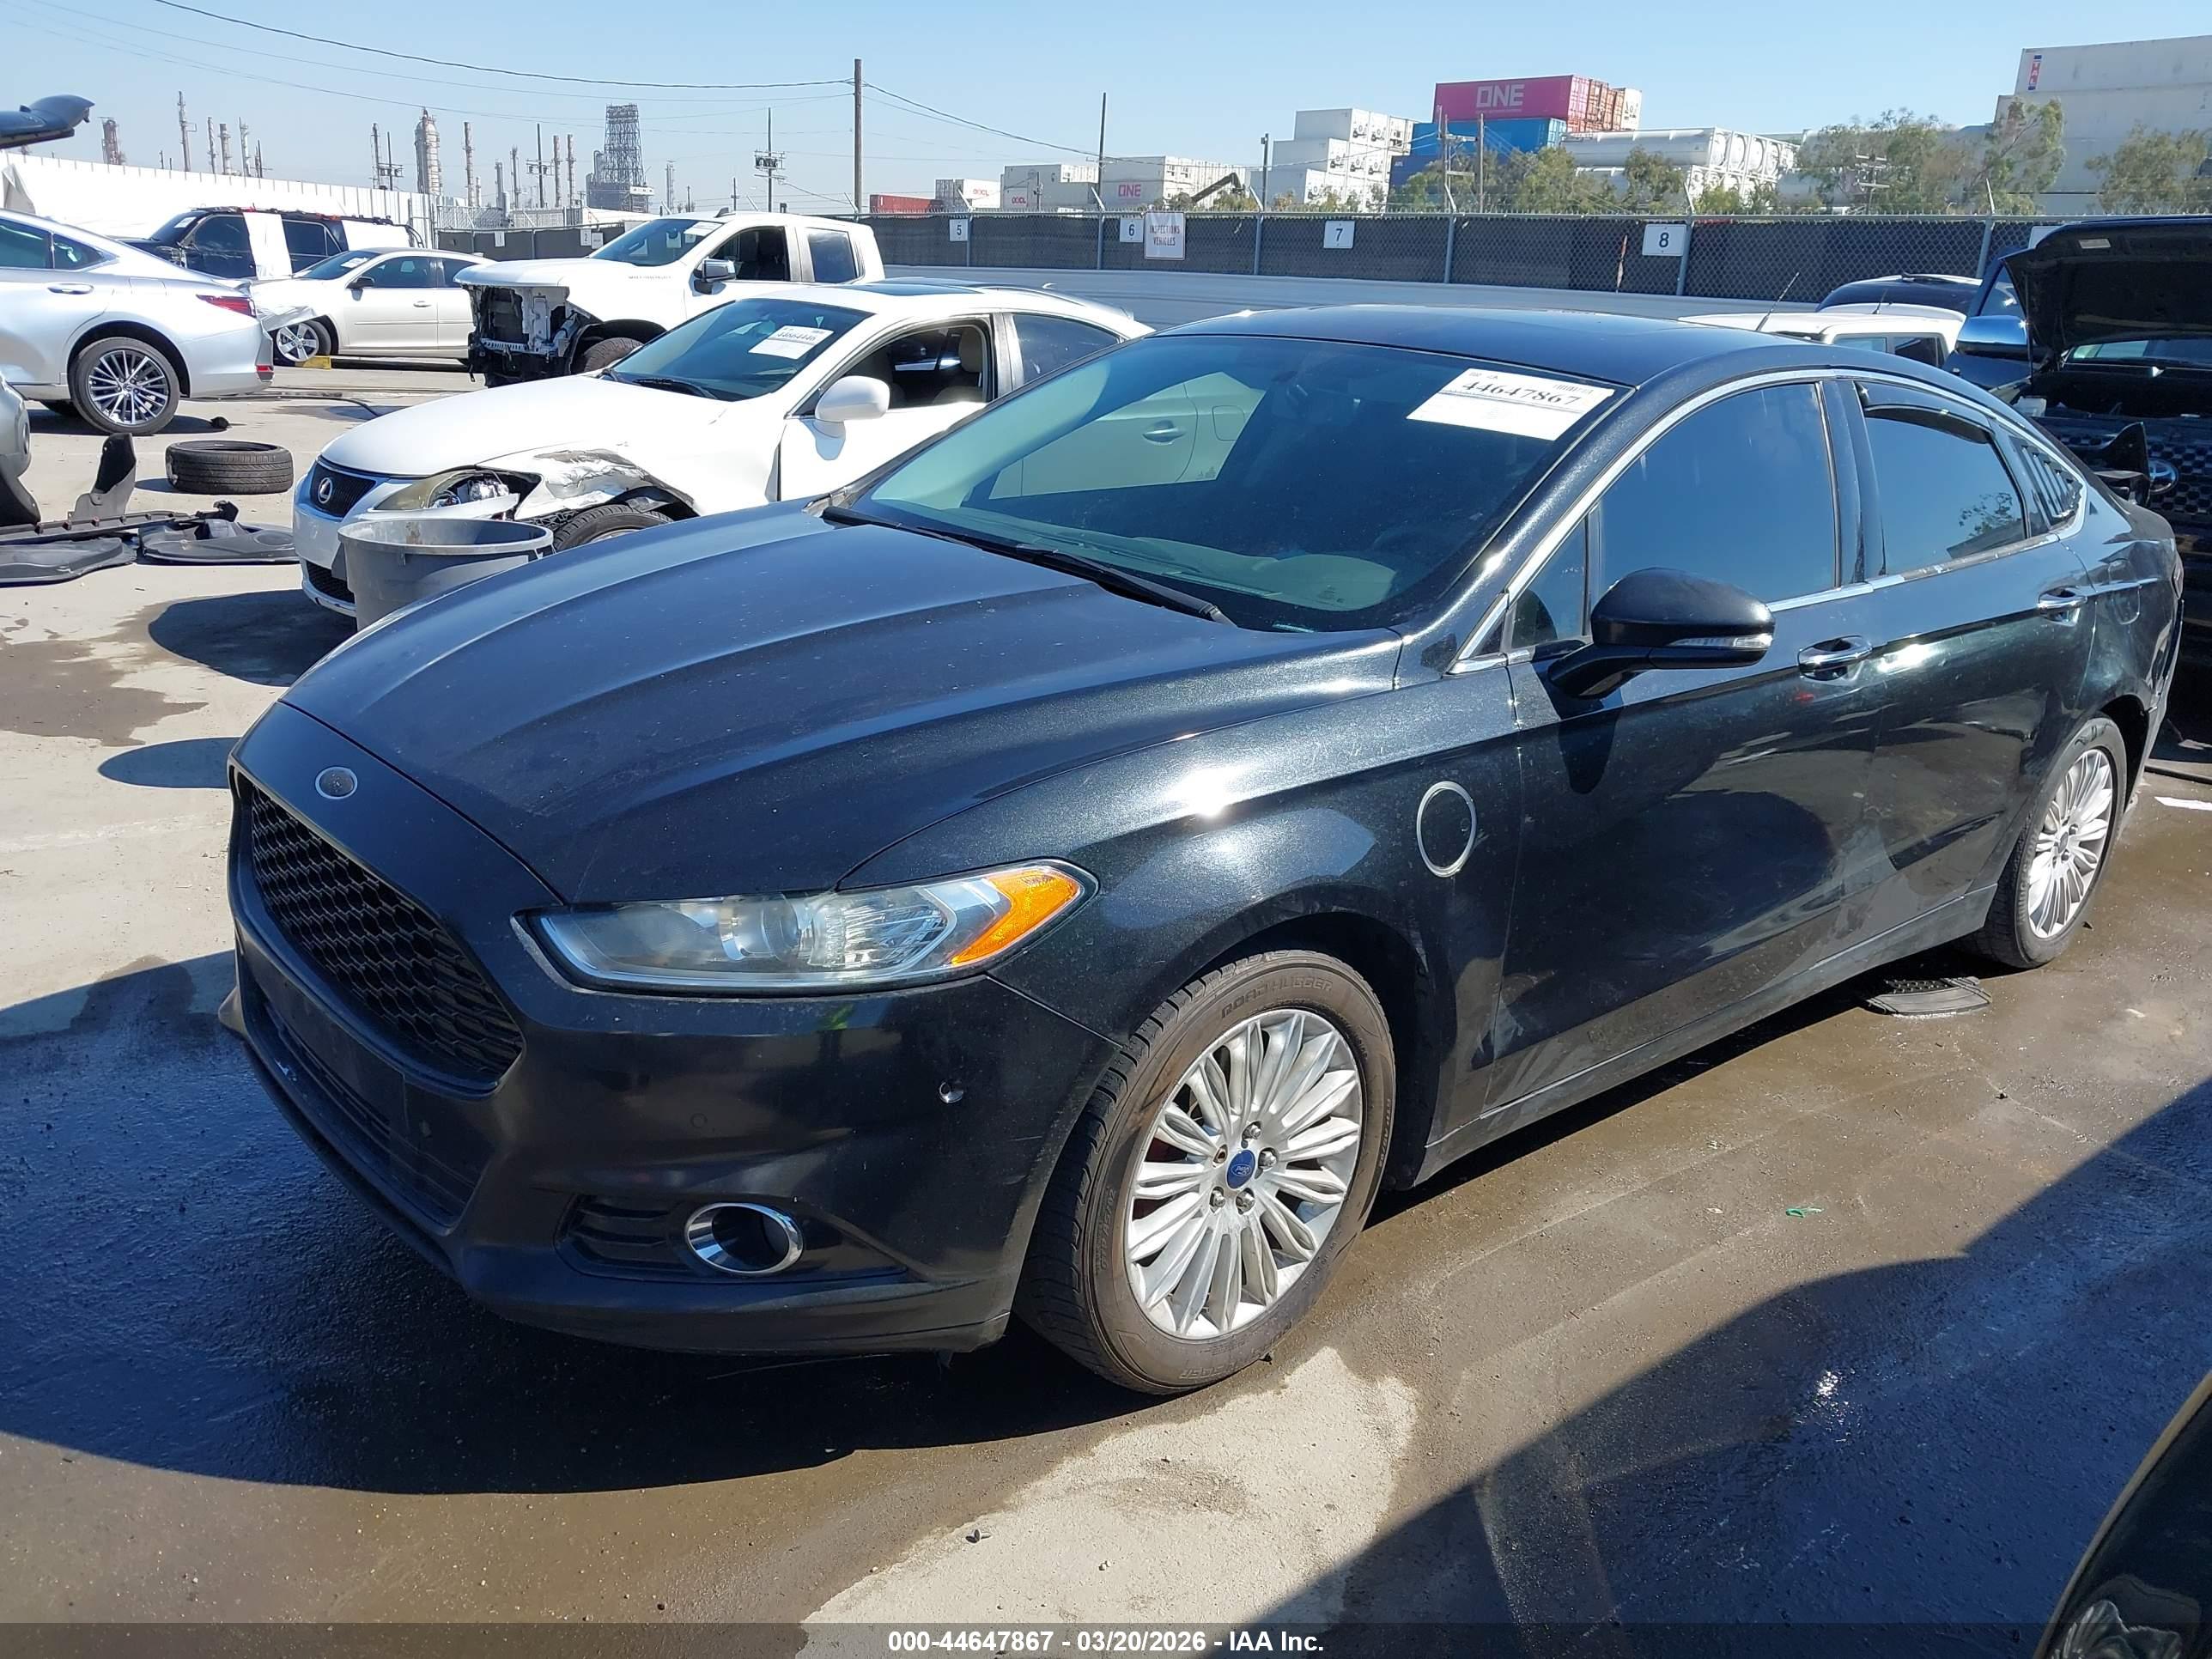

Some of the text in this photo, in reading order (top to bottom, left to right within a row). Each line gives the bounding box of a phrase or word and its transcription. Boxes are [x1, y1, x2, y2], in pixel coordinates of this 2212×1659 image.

[1476, 84, 1525, 108] ONE
[1118, 184, 1141, 197] ONE
[956, 224, 962, 235] 5
[1128, 223, 1135, 236] 6
[1149, 225, 1181, 234] INSPECTIONS
[1335, 228, 1344, 241] 7
[1153, 237, 1176, 246] VEHICLES
[1659, 232, 1669, 248] 8
[1462, 380, 1582, 405] 44647867
